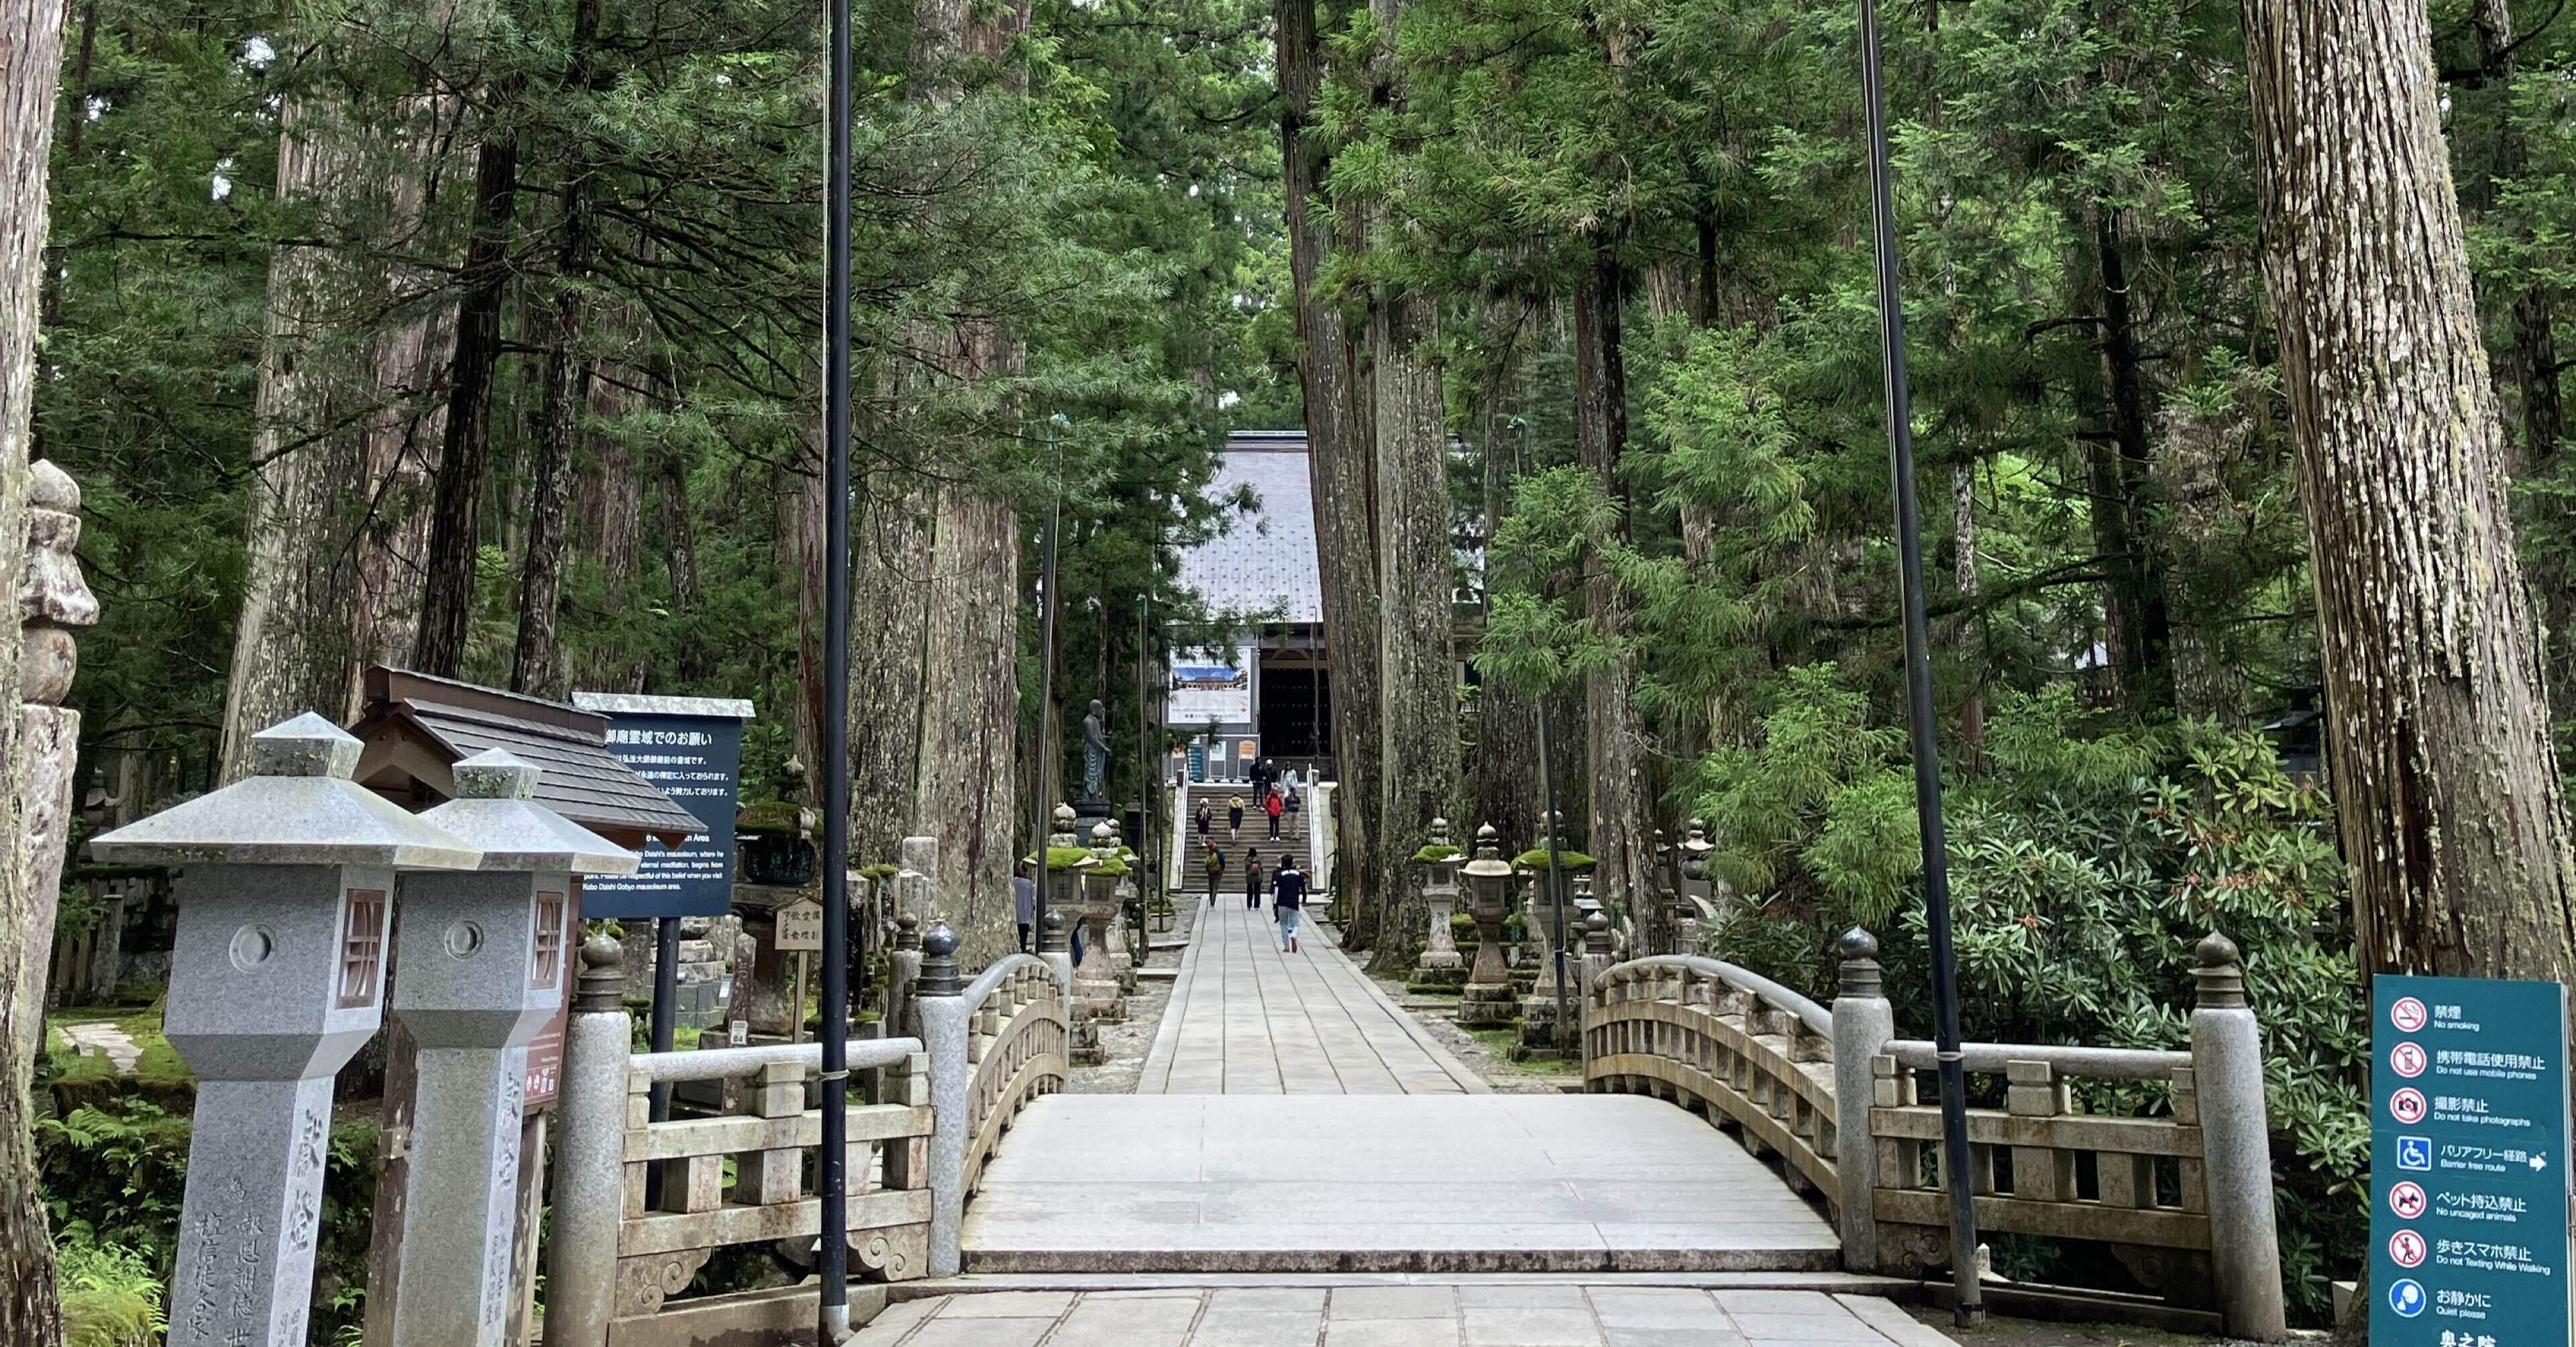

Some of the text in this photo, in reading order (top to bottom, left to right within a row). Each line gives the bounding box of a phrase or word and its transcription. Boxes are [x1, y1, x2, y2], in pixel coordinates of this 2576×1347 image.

[694, 834, 710, 843] Area
[692, 861, 709, 869] begins
[702, 873, 712, 881] you
[617, 883, 635, 892] Gobyo
[2434, 1005, 2462, 1020] 禁煙
[2434, 1020, 2480, 1032] No smoking
[2436, 1050, 2546, 1071] 携帯電話使用禁止
[2436, 1066, 2537, 1080] Do not use mobile phones
[2434, 1095, 2489, 1114] 撮影禁止
[2434, 1112, 2531, 1127] Do not take photographs
[2440, 1144, 2528, 1163] バリアフリー経路
[2440, 1159, 2506, 1173] Barrier free route
[2436, 1191, 2528, 1213] ペット持込禁止
[2436, 1207, 2517, 1223] No uncaged animals
[2436, 1239, 2532, 1262] 歩きスマホ禁止
[2436, 1255, 2551, 1277] Do not Texting While Walking
[2436, 1289, 2491, 1308] お静かに
[2436, 1305, 2486, 1320] Quiet please
